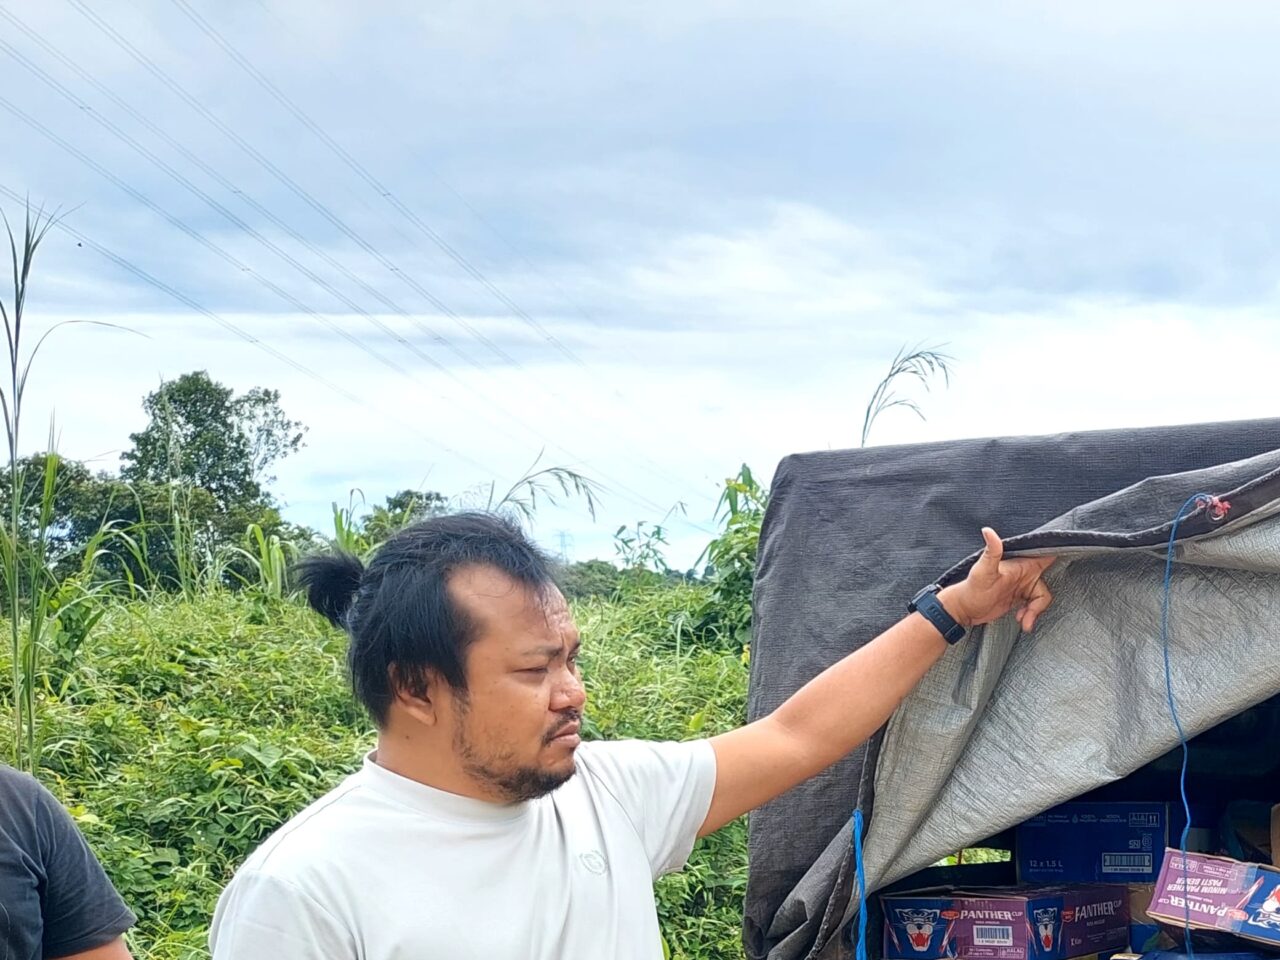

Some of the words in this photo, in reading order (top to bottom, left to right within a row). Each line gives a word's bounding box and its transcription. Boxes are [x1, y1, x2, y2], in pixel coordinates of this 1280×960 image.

[1201, 879, 1223, 887] PASTI
[1201, 885, 1228, 894] MINUM
[1170, 895, 1228, 917] PANTHER
[960, 910, 1012, 920] PANTHER
[1074, 902, 1115, 922] PANTHER
